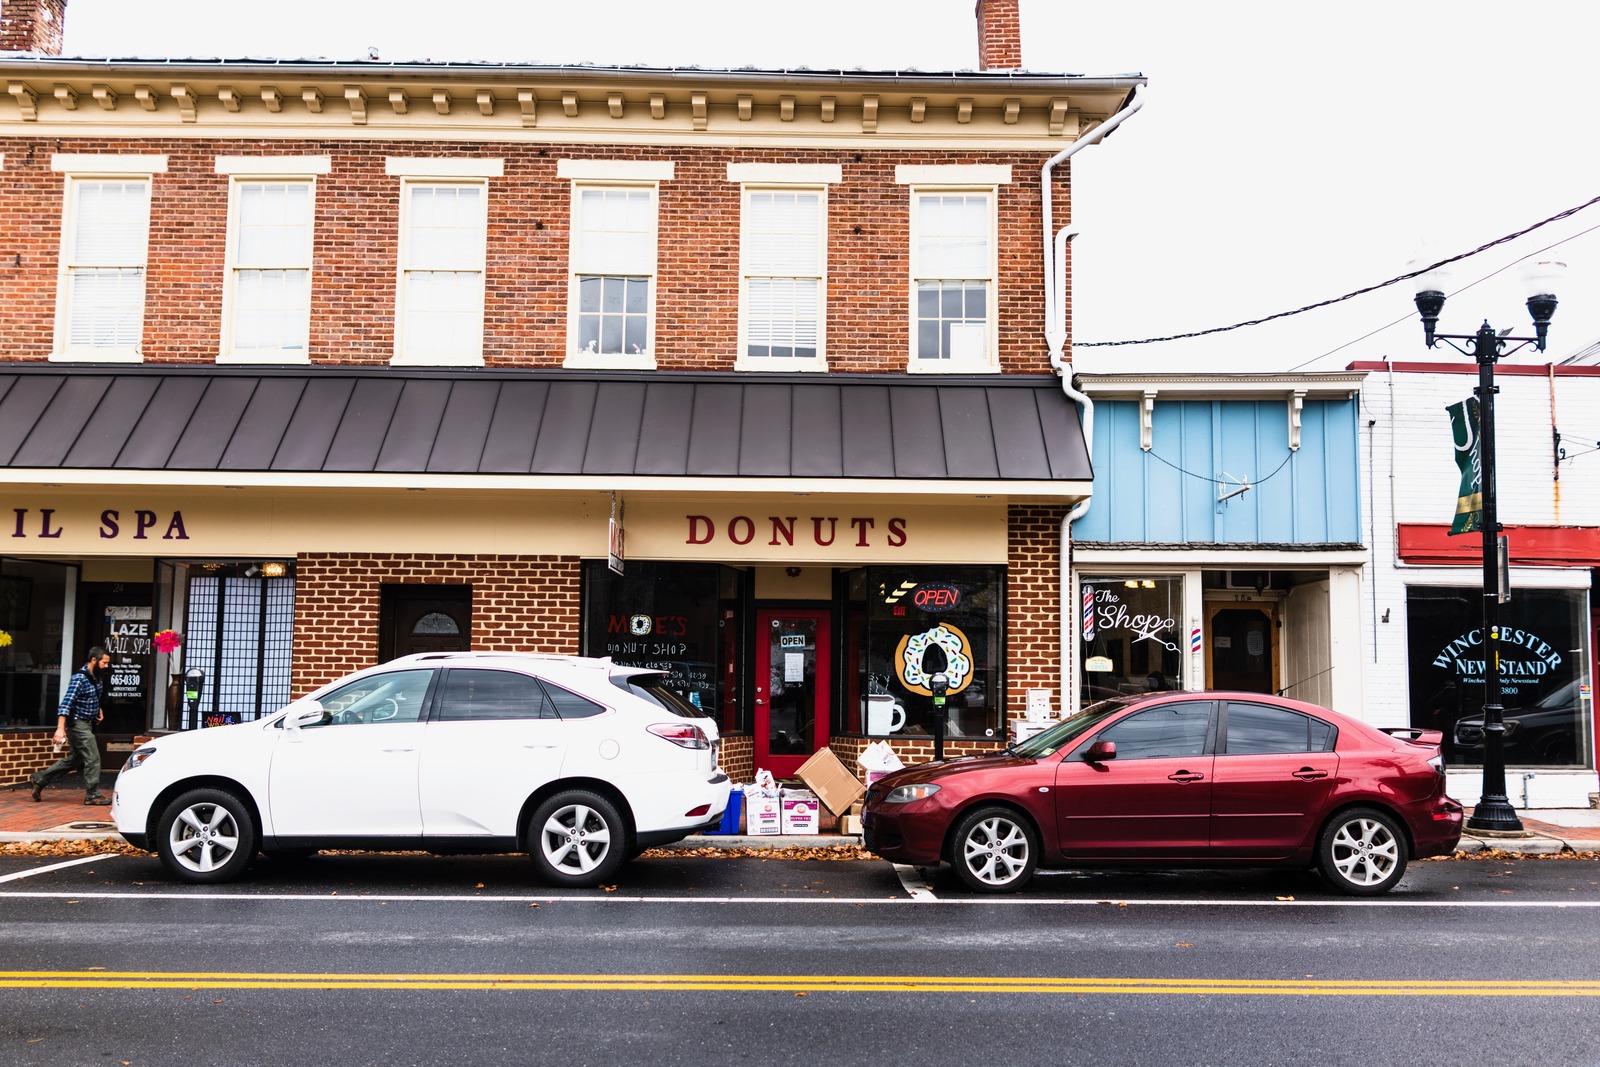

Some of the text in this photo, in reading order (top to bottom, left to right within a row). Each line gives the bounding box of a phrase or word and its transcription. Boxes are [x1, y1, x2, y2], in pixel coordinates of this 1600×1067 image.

[99, 509, 190, 540] SPA
[685, 515, 907, 547] DONUTS
[914, 589, 958, 605] OPEN
[1095, 590, 1120, 603] The
[122, 606, 138, 620] 24
[893, 605, 906, 616] EXIT
[1098, 604, 1164, 639] Shop
[110, 623, 148, 636] LAZE
[104, 637, 151, 655] NAIL SPA
[782, 636, 804, 646] OPEN
[1432, 626, 1562, 670] WINCESTER
[652, 643, 687, 655] SHOP
[110, 674, 140, 686] 665-0330
